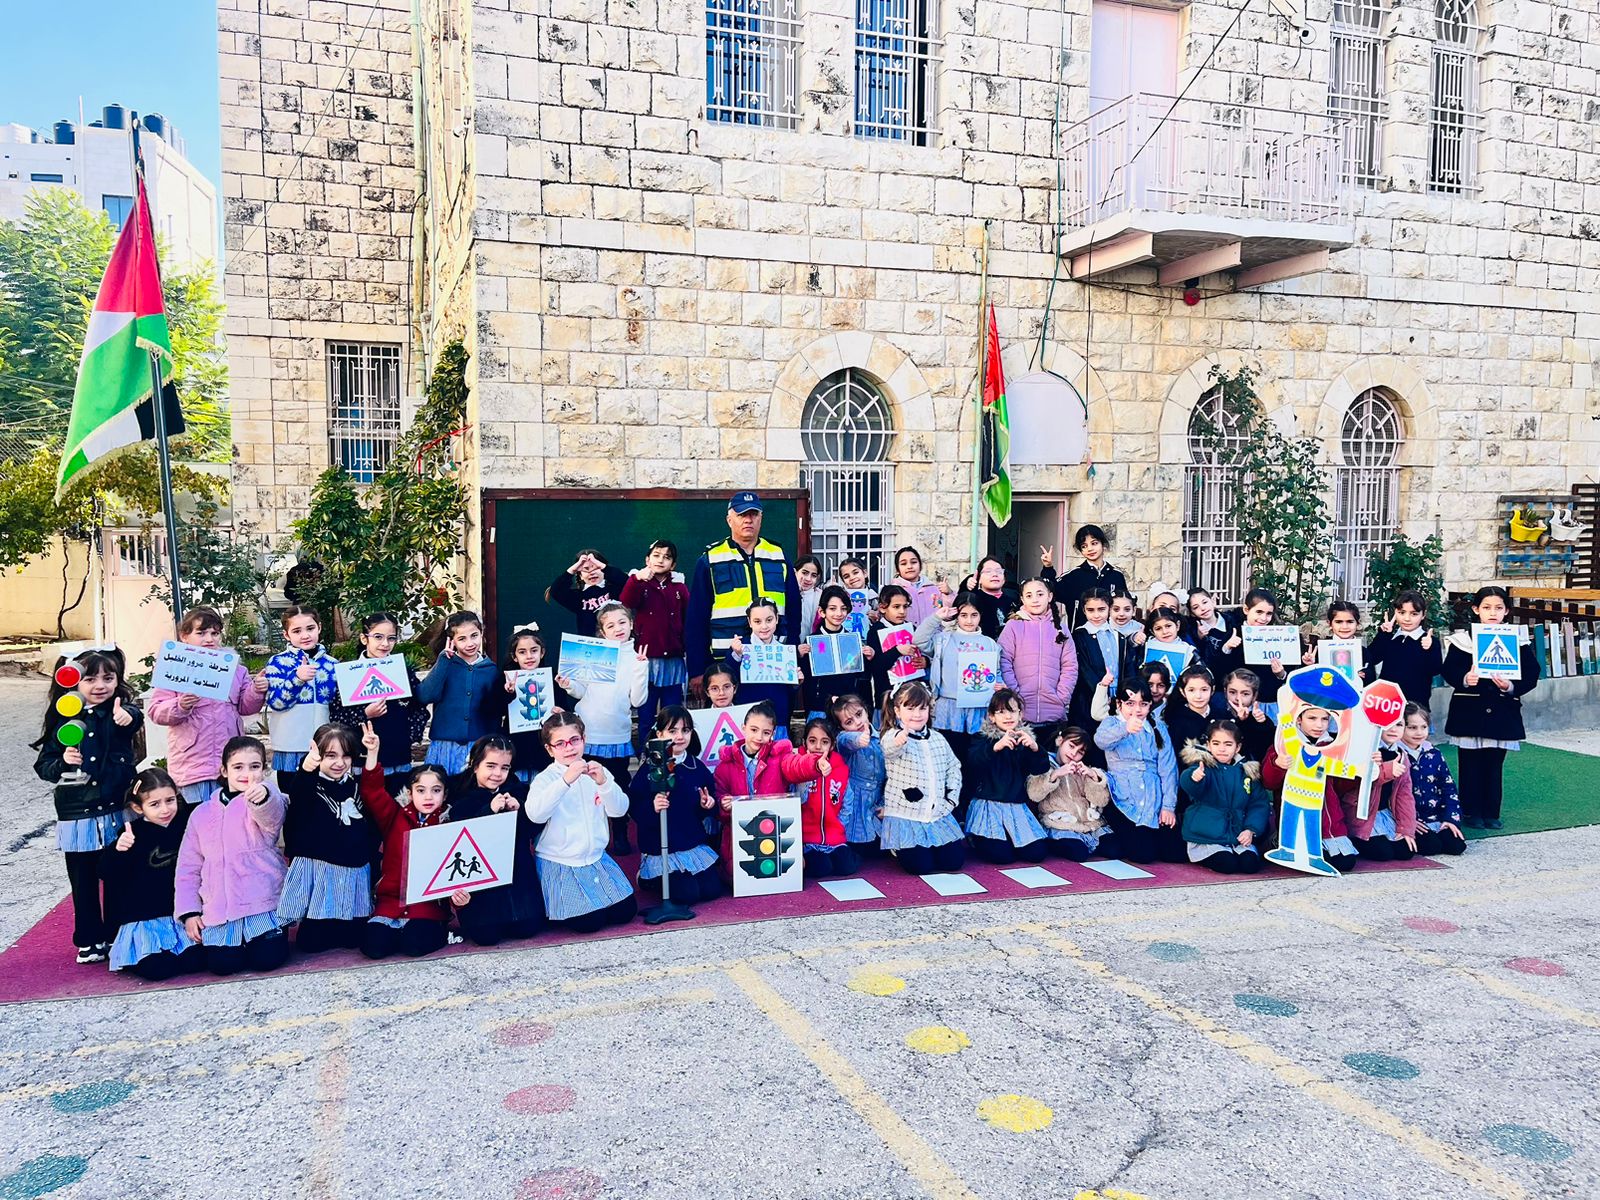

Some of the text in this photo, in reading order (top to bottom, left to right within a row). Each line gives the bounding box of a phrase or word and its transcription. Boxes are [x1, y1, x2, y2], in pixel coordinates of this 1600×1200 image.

[163, 653, 230, 672] شرطة مرور الخليل
[1263, 650, 1281, 660] 100
[164, 671, 220, 689] السلامة المرورية
[1364, 693, 1401, 715] STOP
